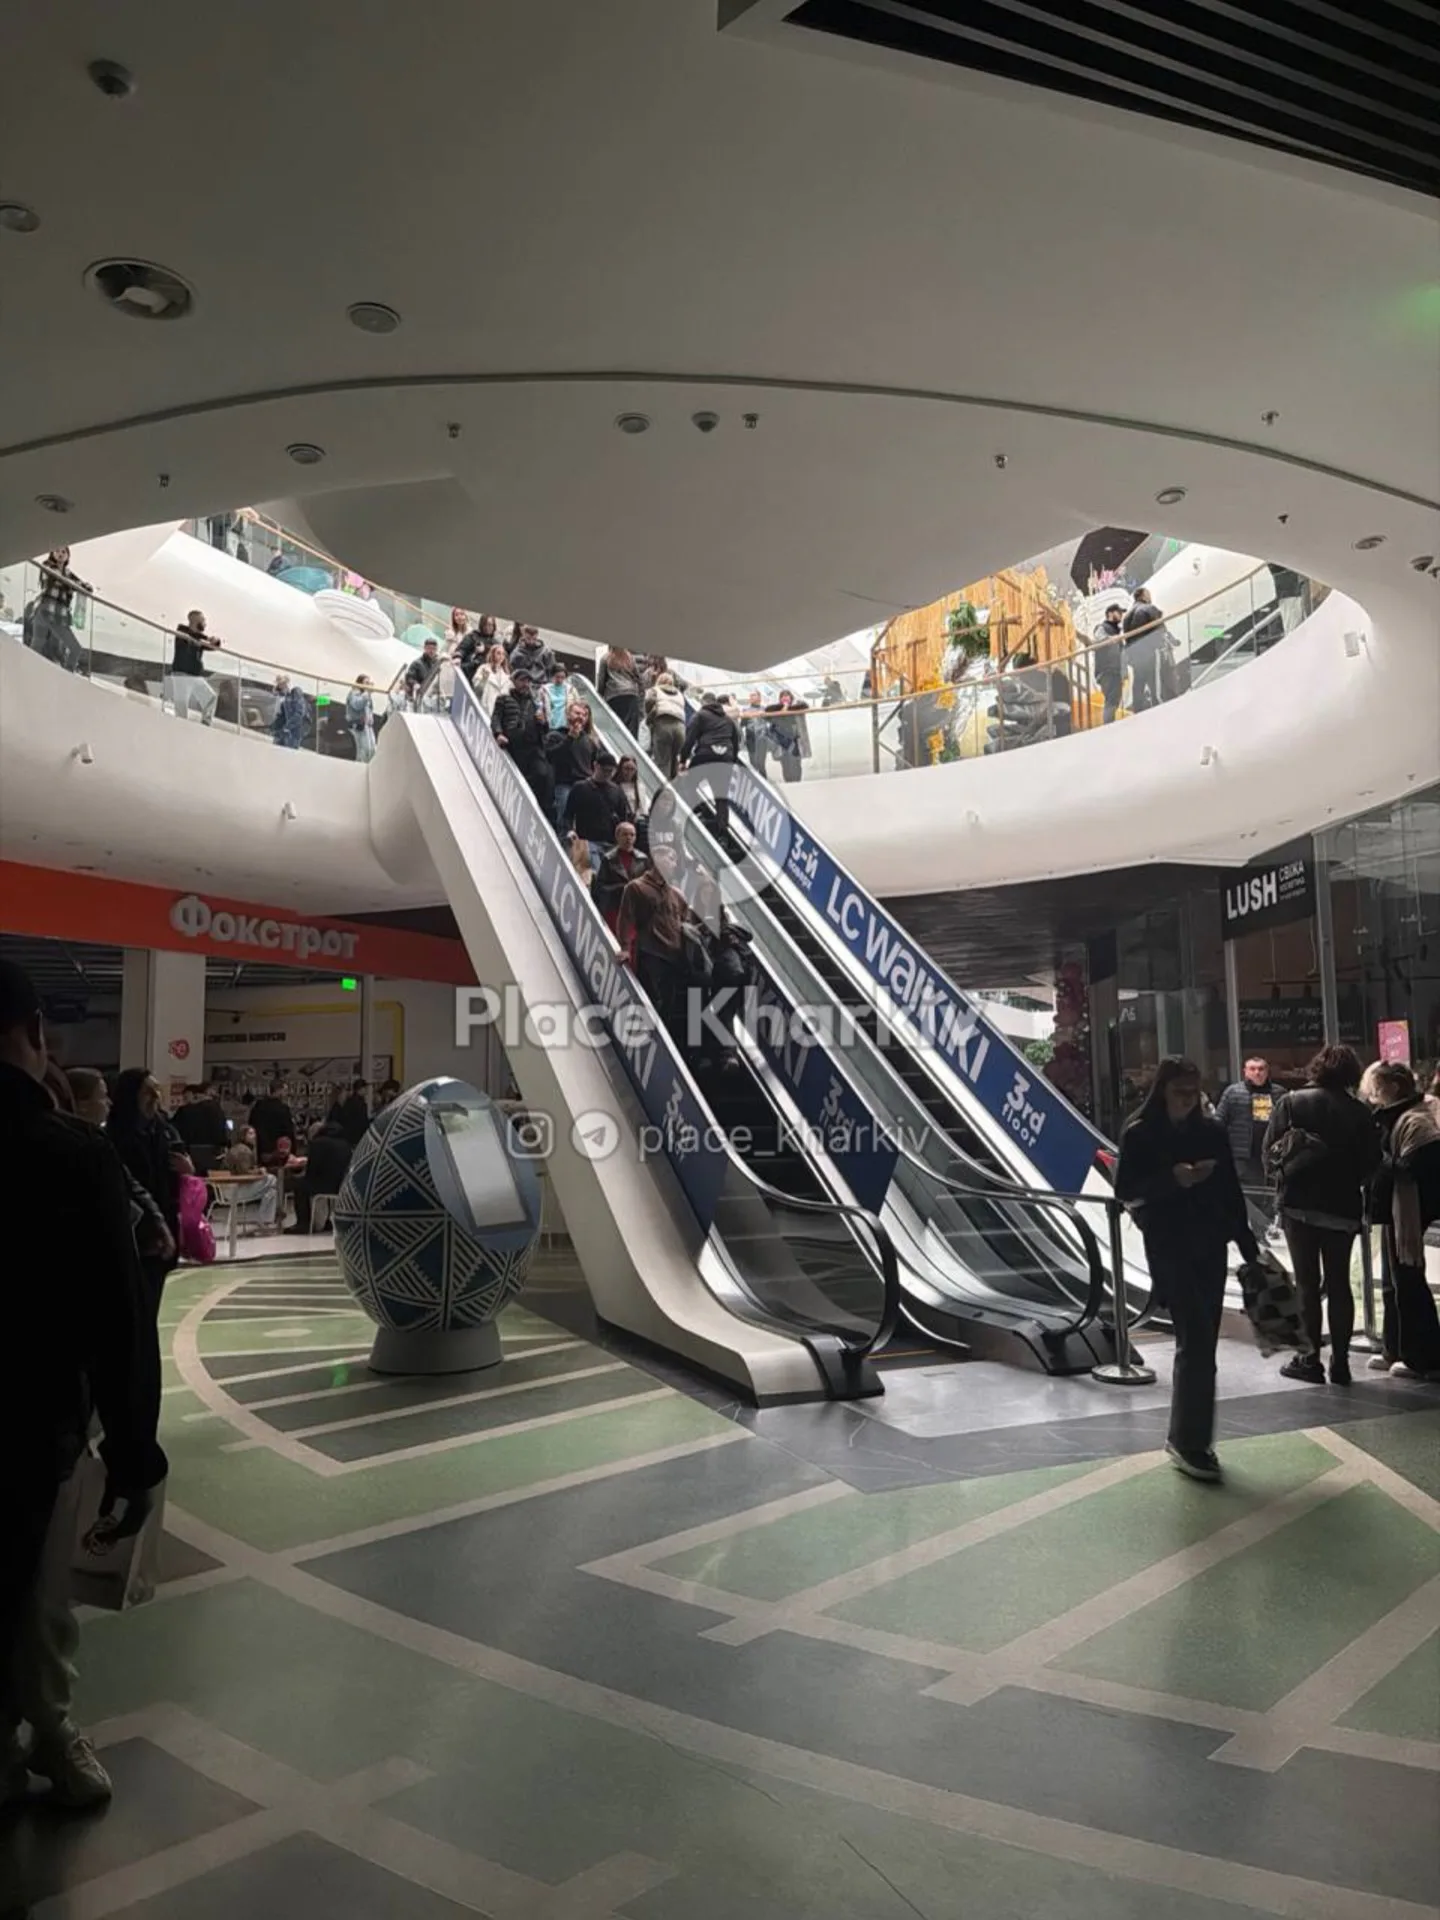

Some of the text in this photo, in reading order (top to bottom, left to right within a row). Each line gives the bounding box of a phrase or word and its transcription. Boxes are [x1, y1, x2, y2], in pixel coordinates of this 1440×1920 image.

[550, 864, 577, 933] LC
[826, 875, 865, 941] LC
[1226, 870, 1278, 920] LUSH
[169, 895, 360, 960] Фокстрот
[1001, 1102, 1037, 1149] floor
[1006, 1071, 1046, 1135] 3rd
